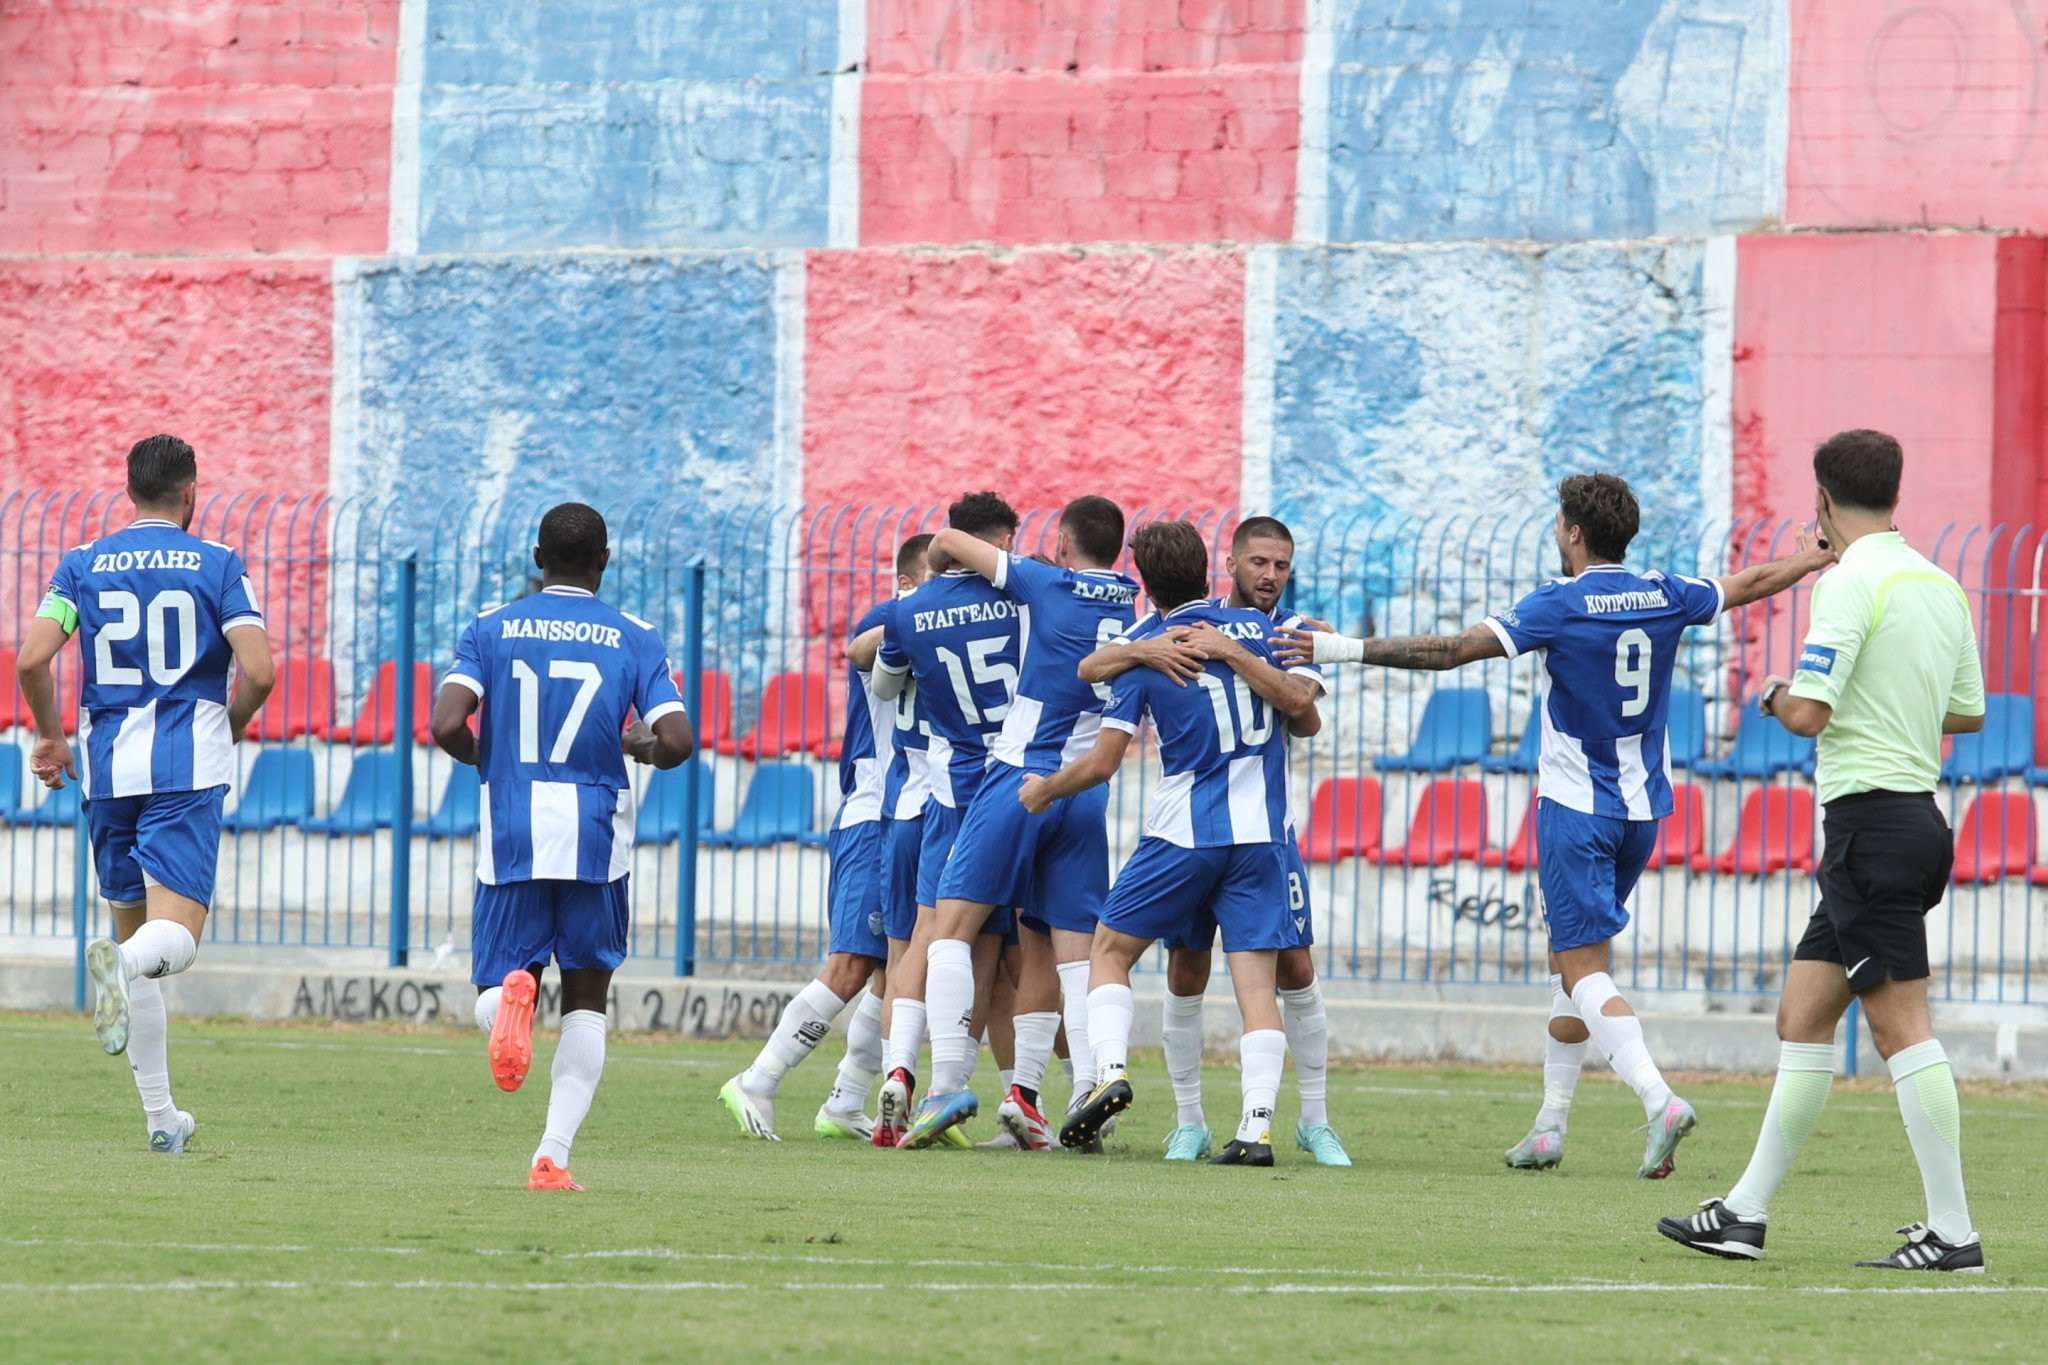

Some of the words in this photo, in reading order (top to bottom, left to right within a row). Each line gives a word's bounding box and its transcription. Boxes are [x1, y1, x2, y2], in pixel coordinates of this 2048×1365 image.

[91, 549, 201, 573] ΖΙΟΥΛΗΣ
[94, 589, 197, 686] 20
[501, 618, 621, 648] MANSSOUR
[1615, 628, 1652, 717] 9
[512, 659, 603, 763] 17
[935, 635, 1019, 725] 15
[1197, 657, 1274, 754] 10
[1288, 872, 1304, 911] 8
